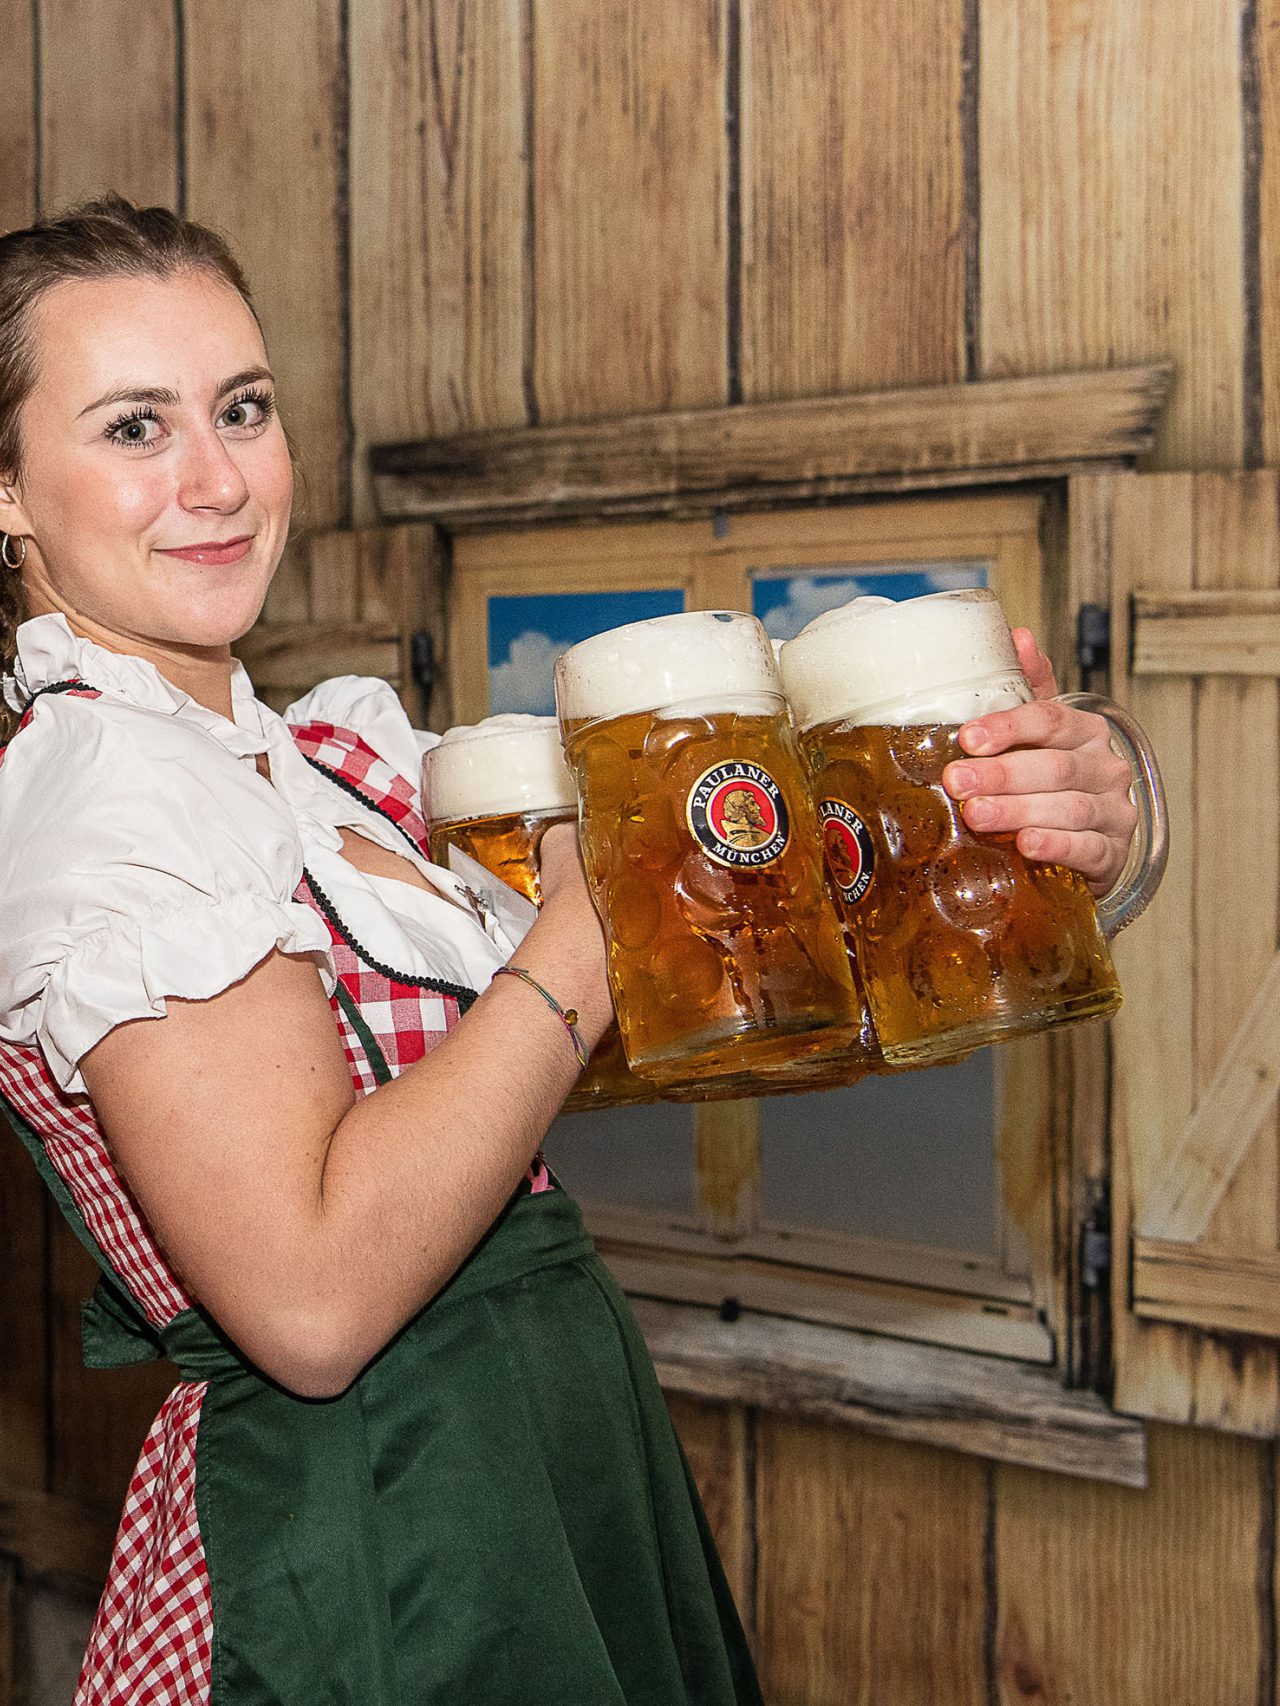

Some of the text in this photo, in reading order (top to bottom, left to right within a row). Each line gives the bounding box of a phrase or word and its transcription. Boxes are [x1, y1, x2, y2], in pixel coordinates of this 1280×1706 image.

[693, 764, 780, 809] PAULANER
[819, 802, 863, 835] LANER
[712, 831, 786, 863] MÜNCHEN
[843, 872, 870, 903] NCHEN
